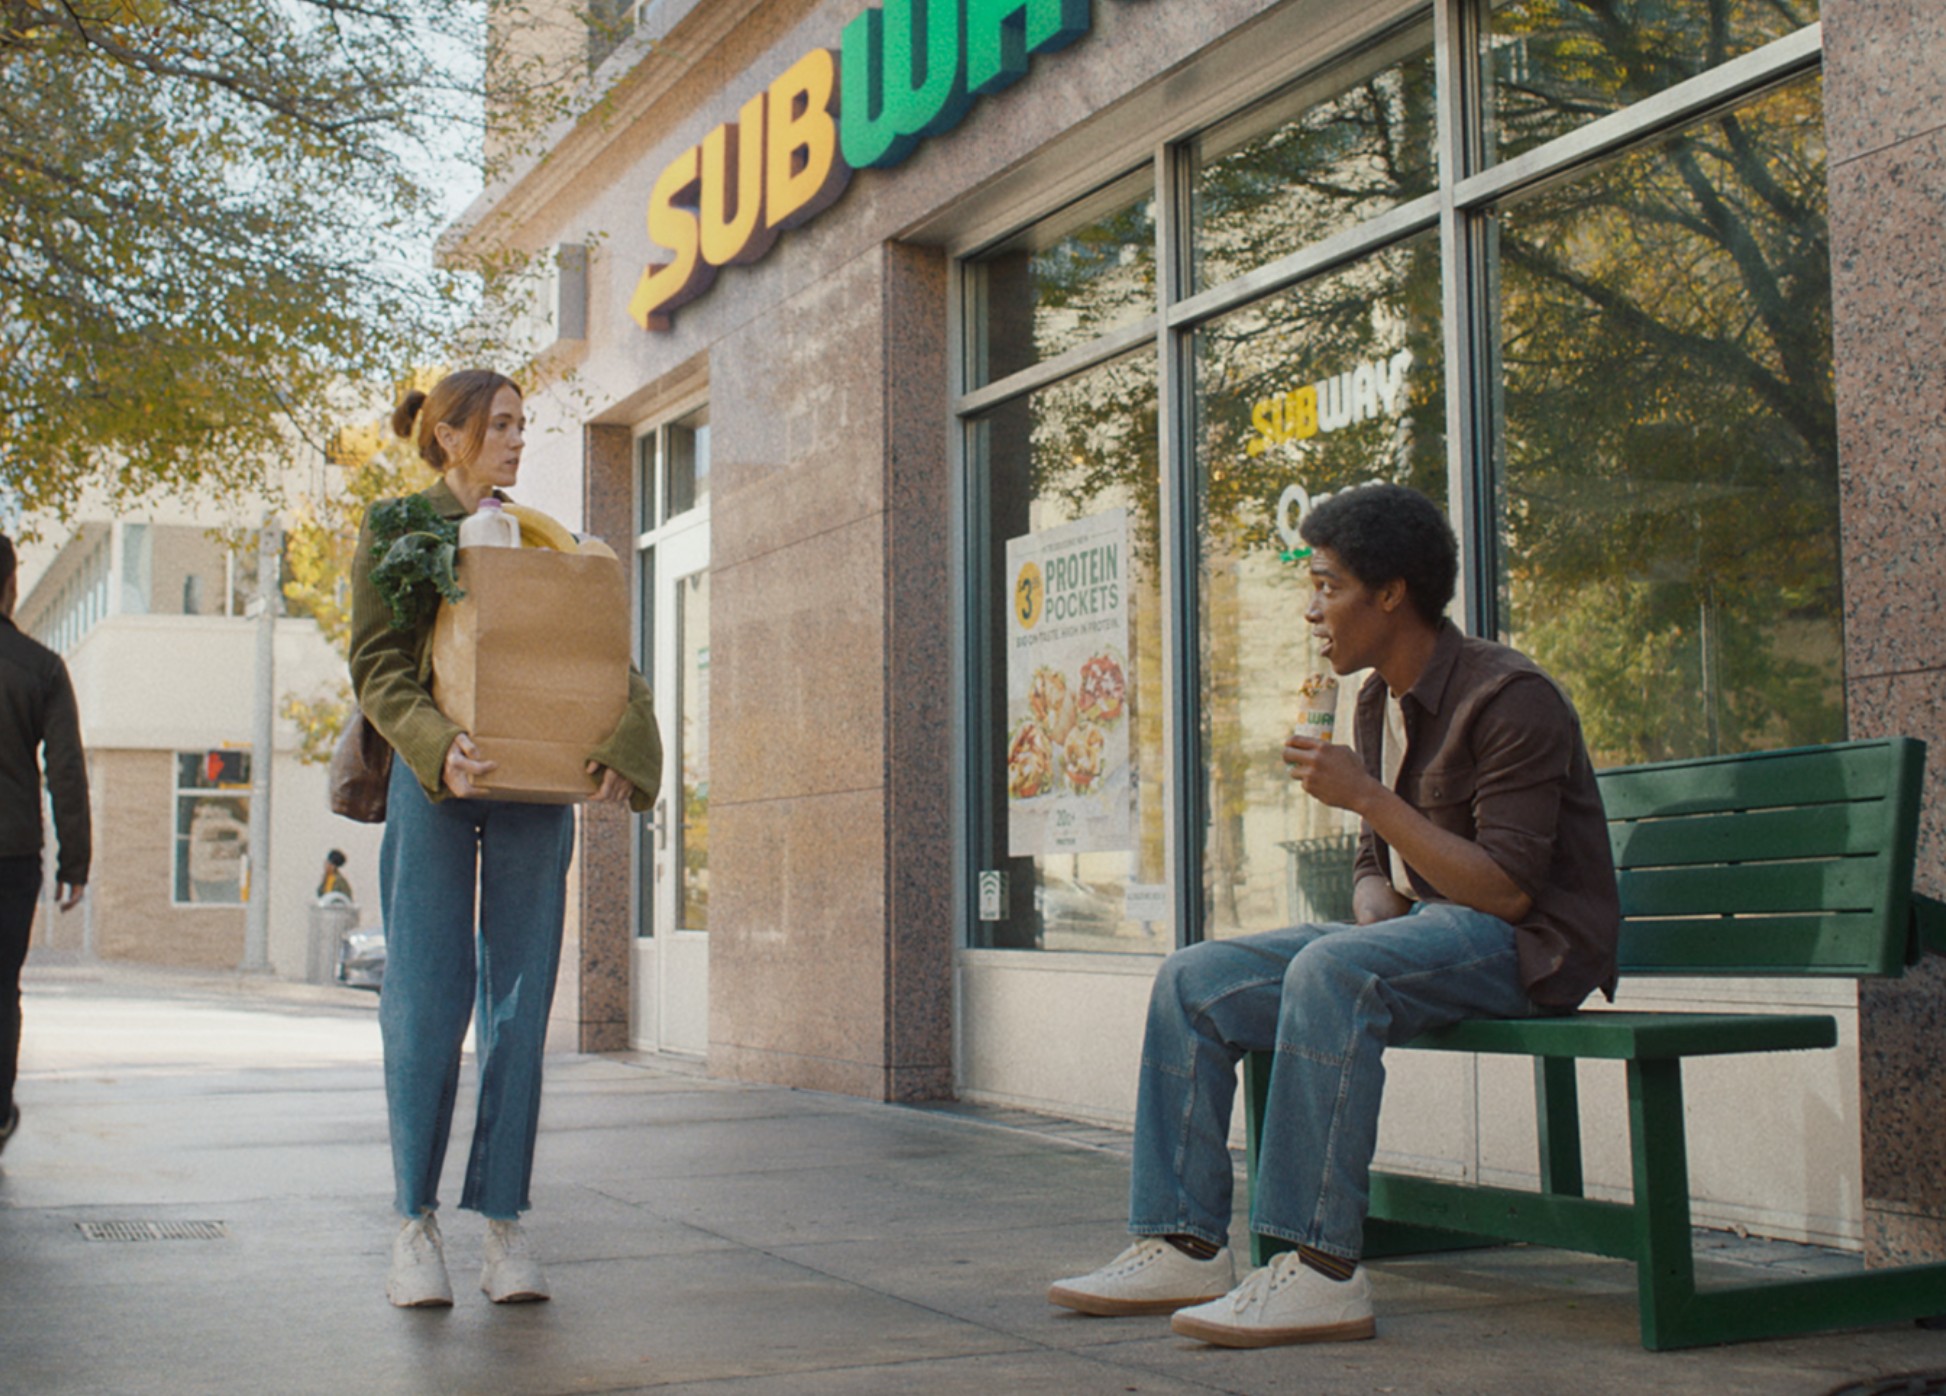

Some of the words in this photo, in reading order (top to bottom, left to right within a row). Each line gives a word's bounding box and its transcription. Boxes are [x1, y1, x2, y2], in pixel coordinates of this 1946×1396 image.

[627, 0, 1092, 331] SUBWA
[1247, 347, 1413, 457] SUBWAY
[1045, 543, 1118, 594] PROTEIN
[1045, 583, 1119, 622] POCKETS
